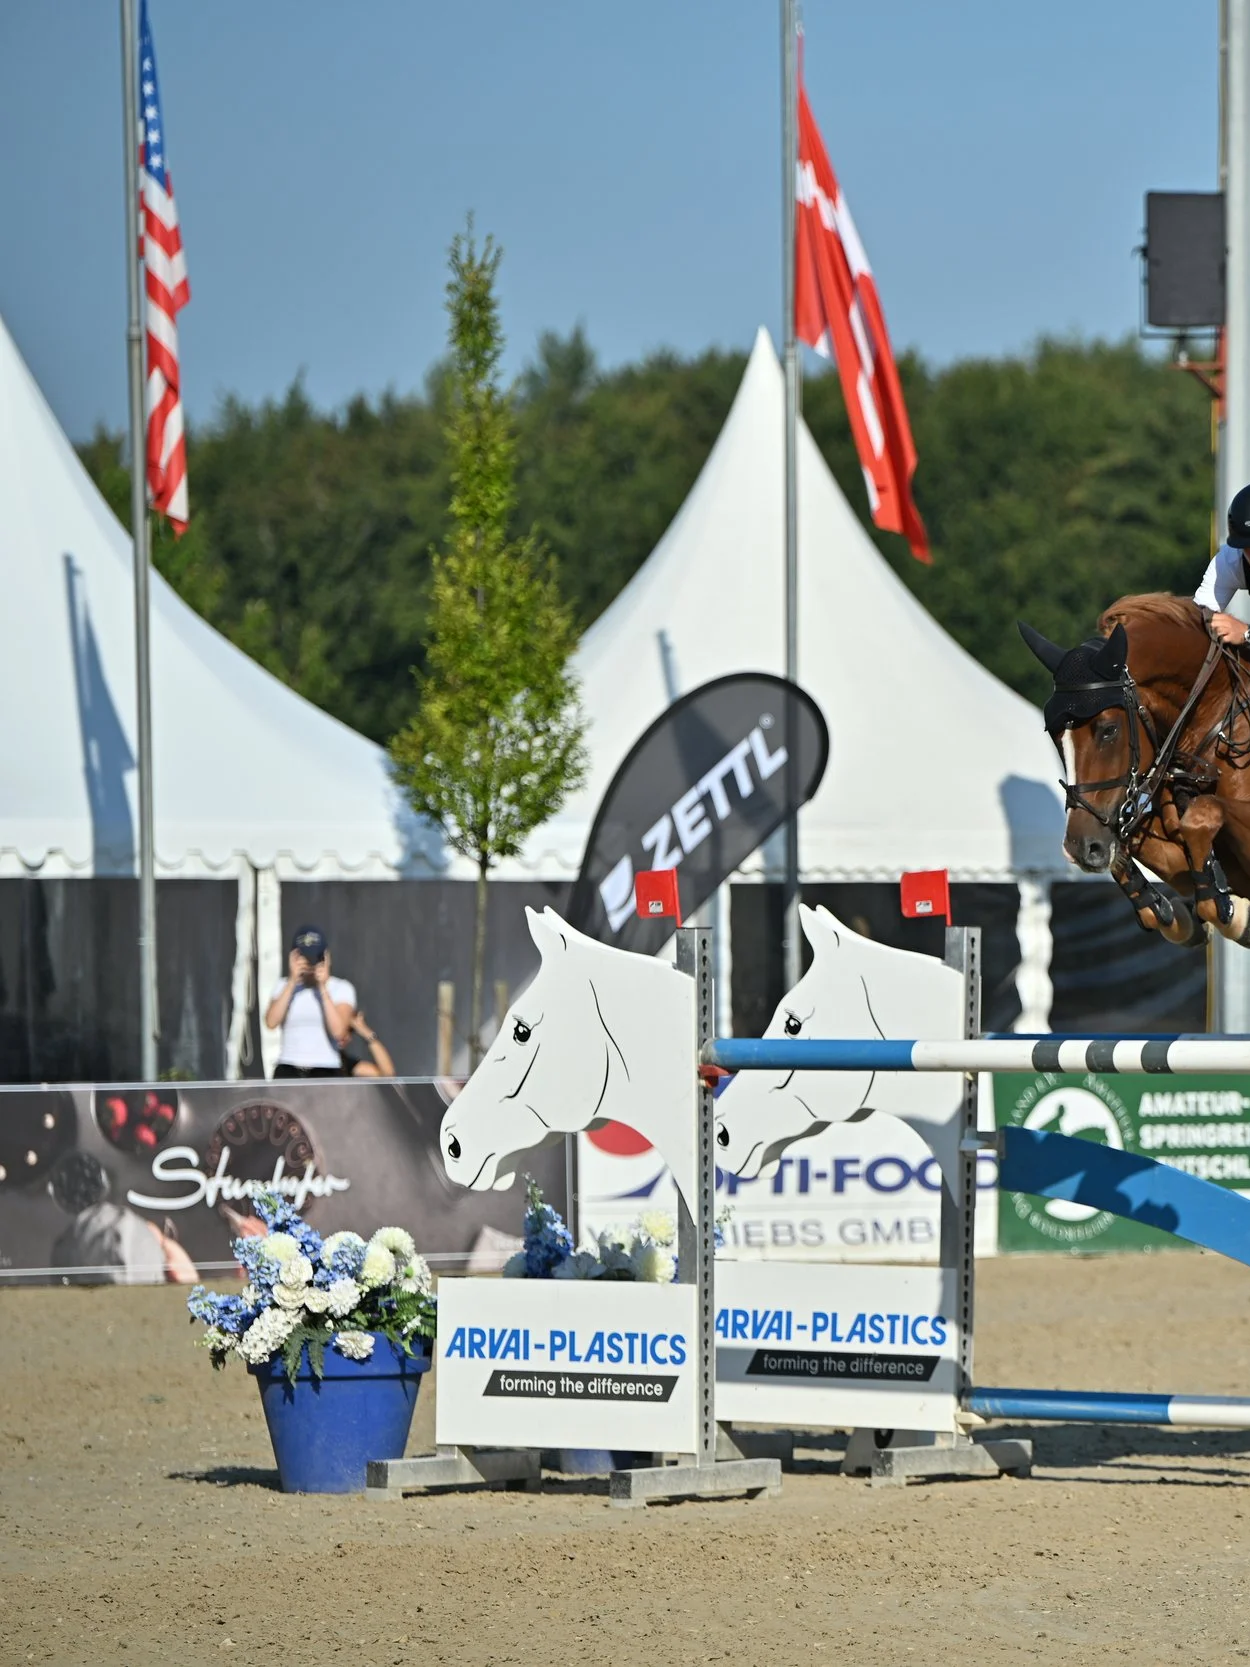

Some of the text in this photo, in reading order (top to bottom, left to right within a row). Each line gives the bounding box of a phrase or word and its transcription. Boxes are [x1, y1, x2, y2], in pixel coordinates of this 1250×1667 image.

[641, 726, 789, 871] ZETTL
[716, 1309, 947, 1345] ARVAI-PLASTICS
[445, 1327, 686, 1365] ARVAI-PLASTICS
[763, 1354, 924, 1376] forming the difference
[500, 1374, 663, 1396] forming the difference
